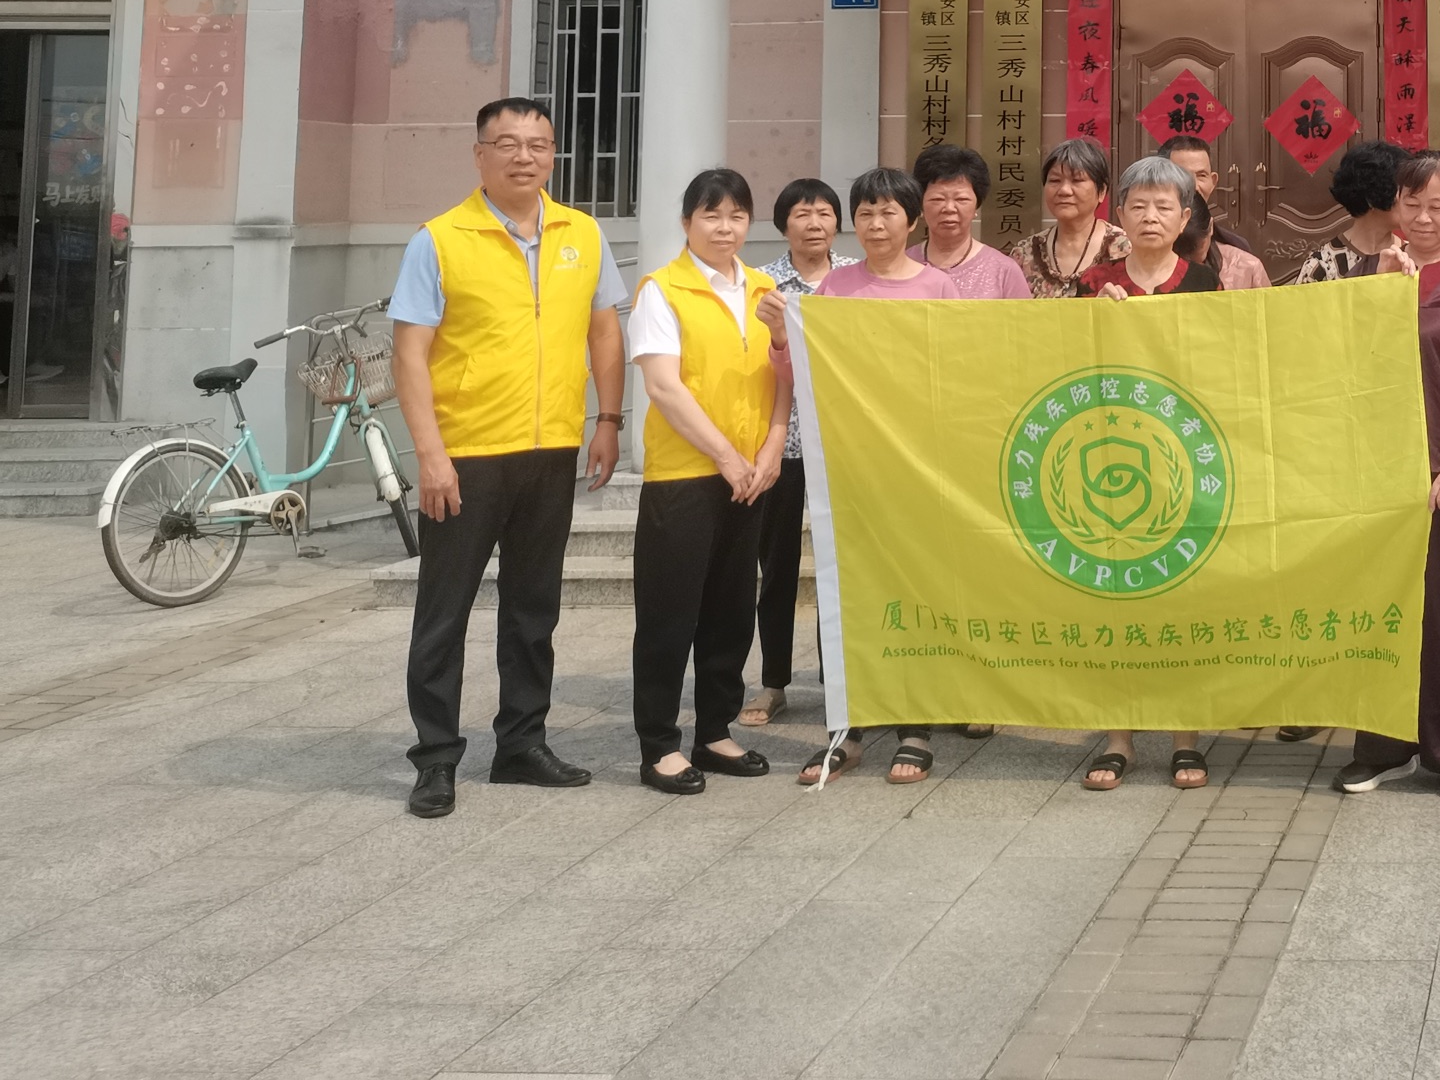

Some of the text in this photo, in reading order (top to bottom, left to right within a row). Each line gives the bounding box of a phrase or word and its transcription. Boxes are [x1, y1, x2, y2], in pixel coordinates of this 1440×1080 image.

[1168, 92, 1206, 133] 福
[1294, 98, 1332, 140] 福
[882, 643, 964, 658] Association
[979, 656, 1055, 669] Volunteers
[1059, 657, 1079, 669] for
[1083, 659, 1106, 670] the
[1110, 658, 1189, 670] Prevention
[1193, 654, 1221, 666] and
[1225, 653, 1276, 667] Control
[1279, 655, 1293, 668] of
[1297, 651, 1340, 668] Visual
[1344, 647, 1401, 669] Disability
